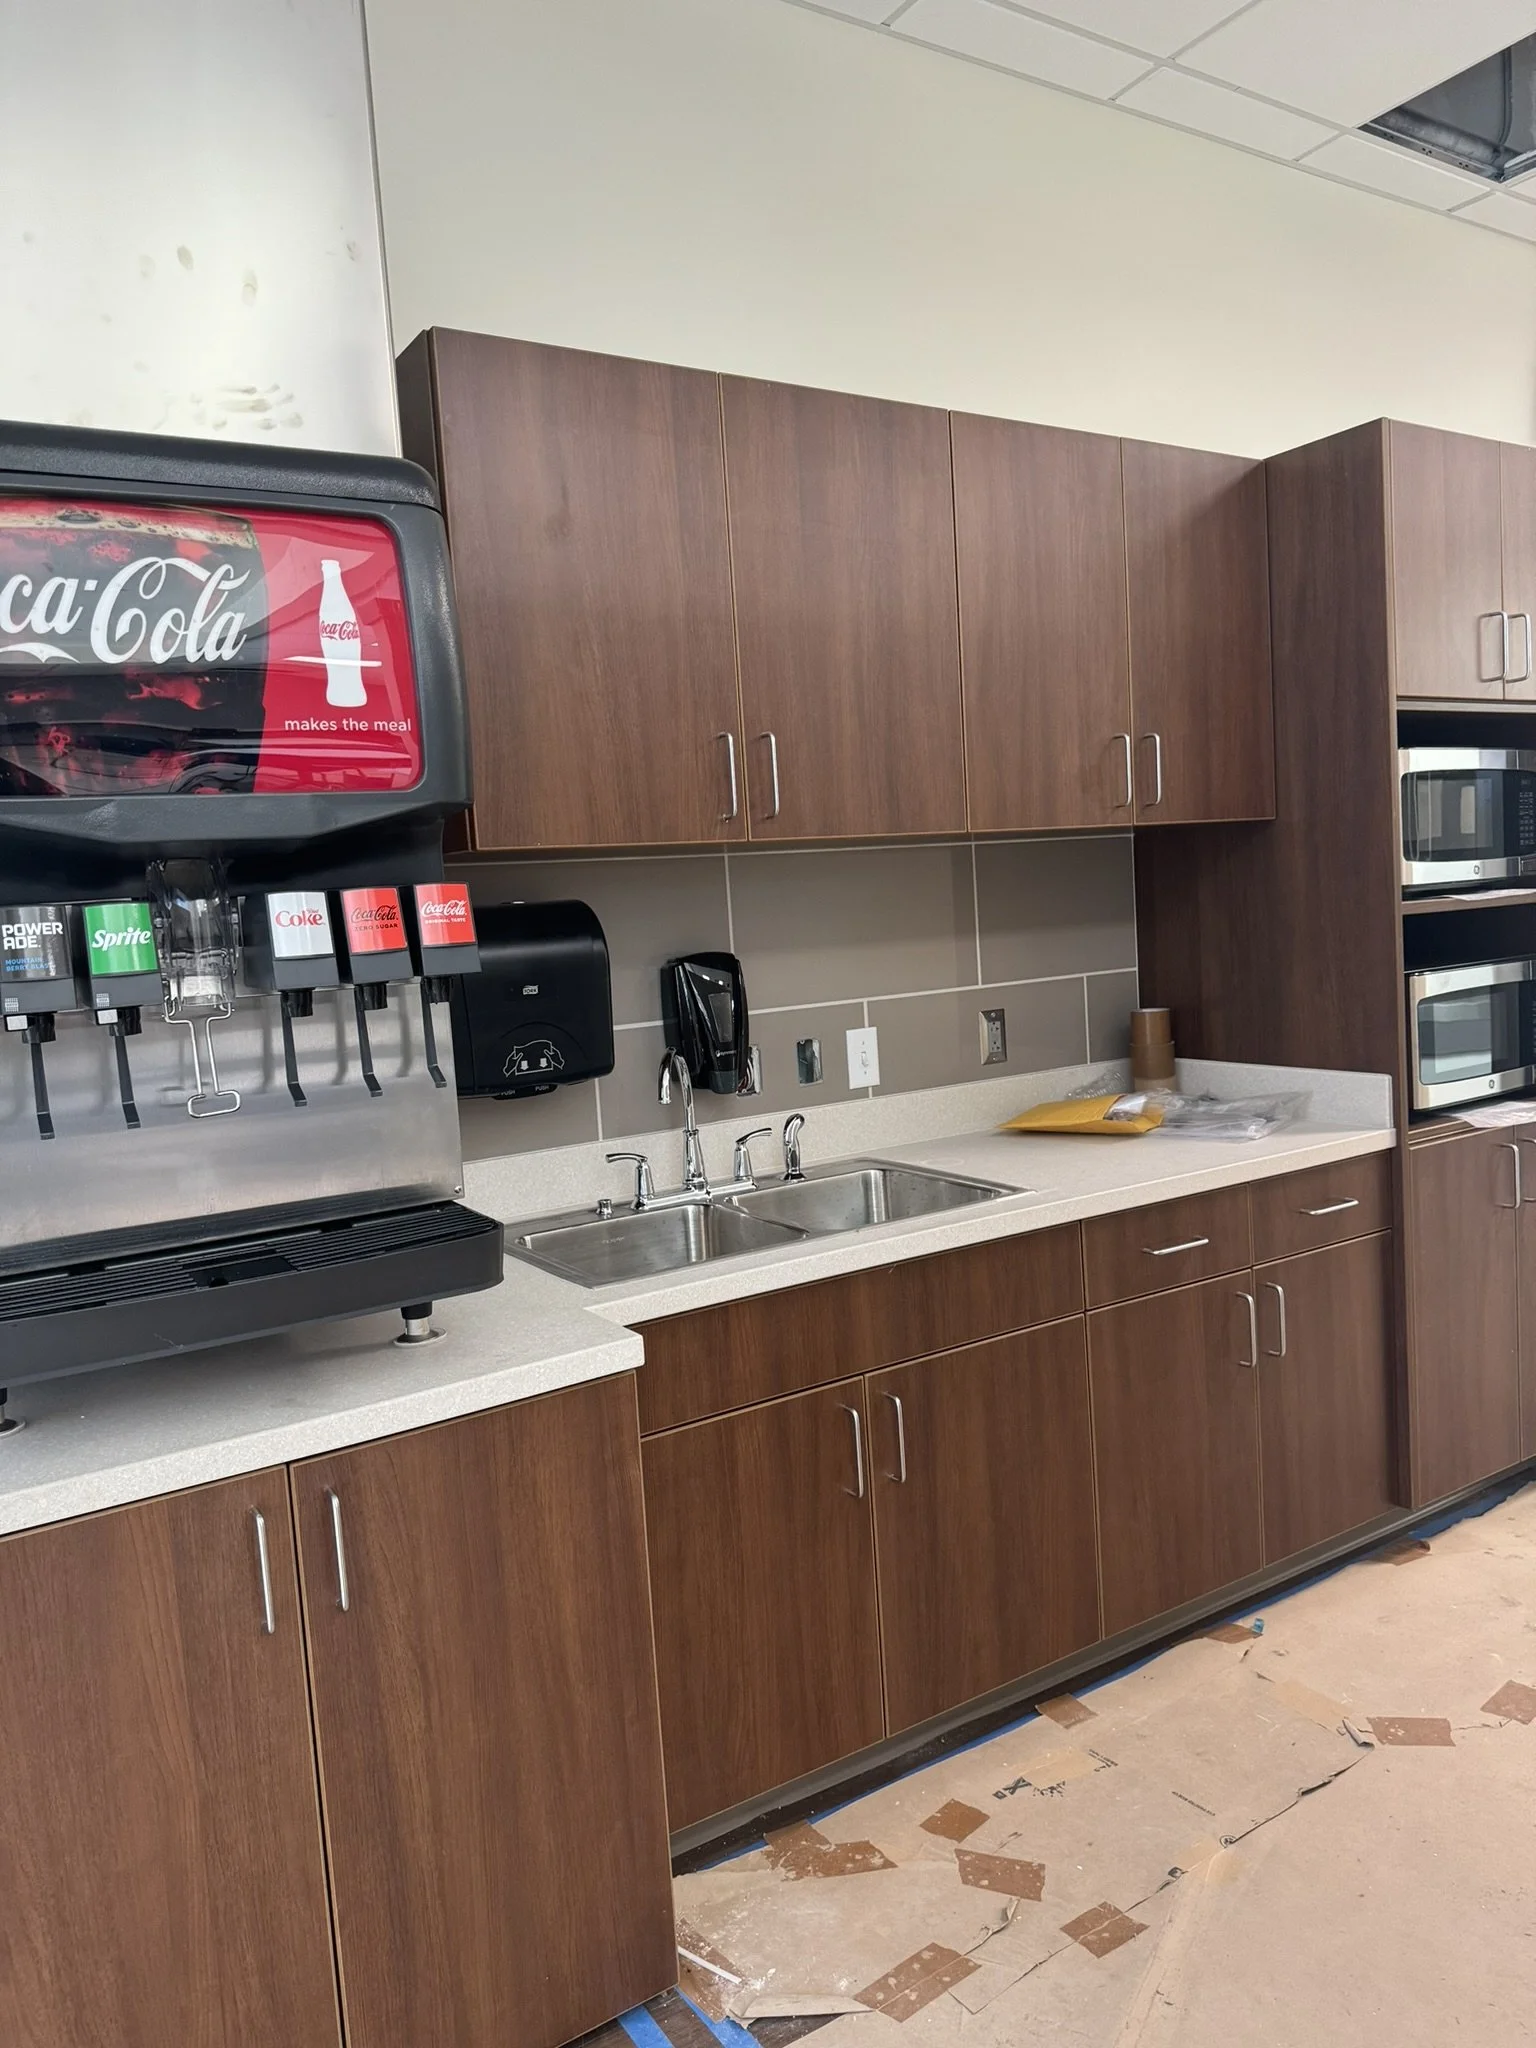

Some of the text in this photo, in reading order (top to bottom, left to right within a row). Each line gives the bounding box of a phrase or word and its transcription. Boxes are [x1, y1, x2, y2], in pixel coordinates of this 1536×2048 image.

[284, 717, 412, 732] makes the meal
[351, 905, 397, 923] Coca-Cola
[421, 899, 467, 917] Coca-Cola
[275, 910, 326, 927] Coke
[1, 921, 64, 938] POWER
[91, 926, 151, 952] Sprite
